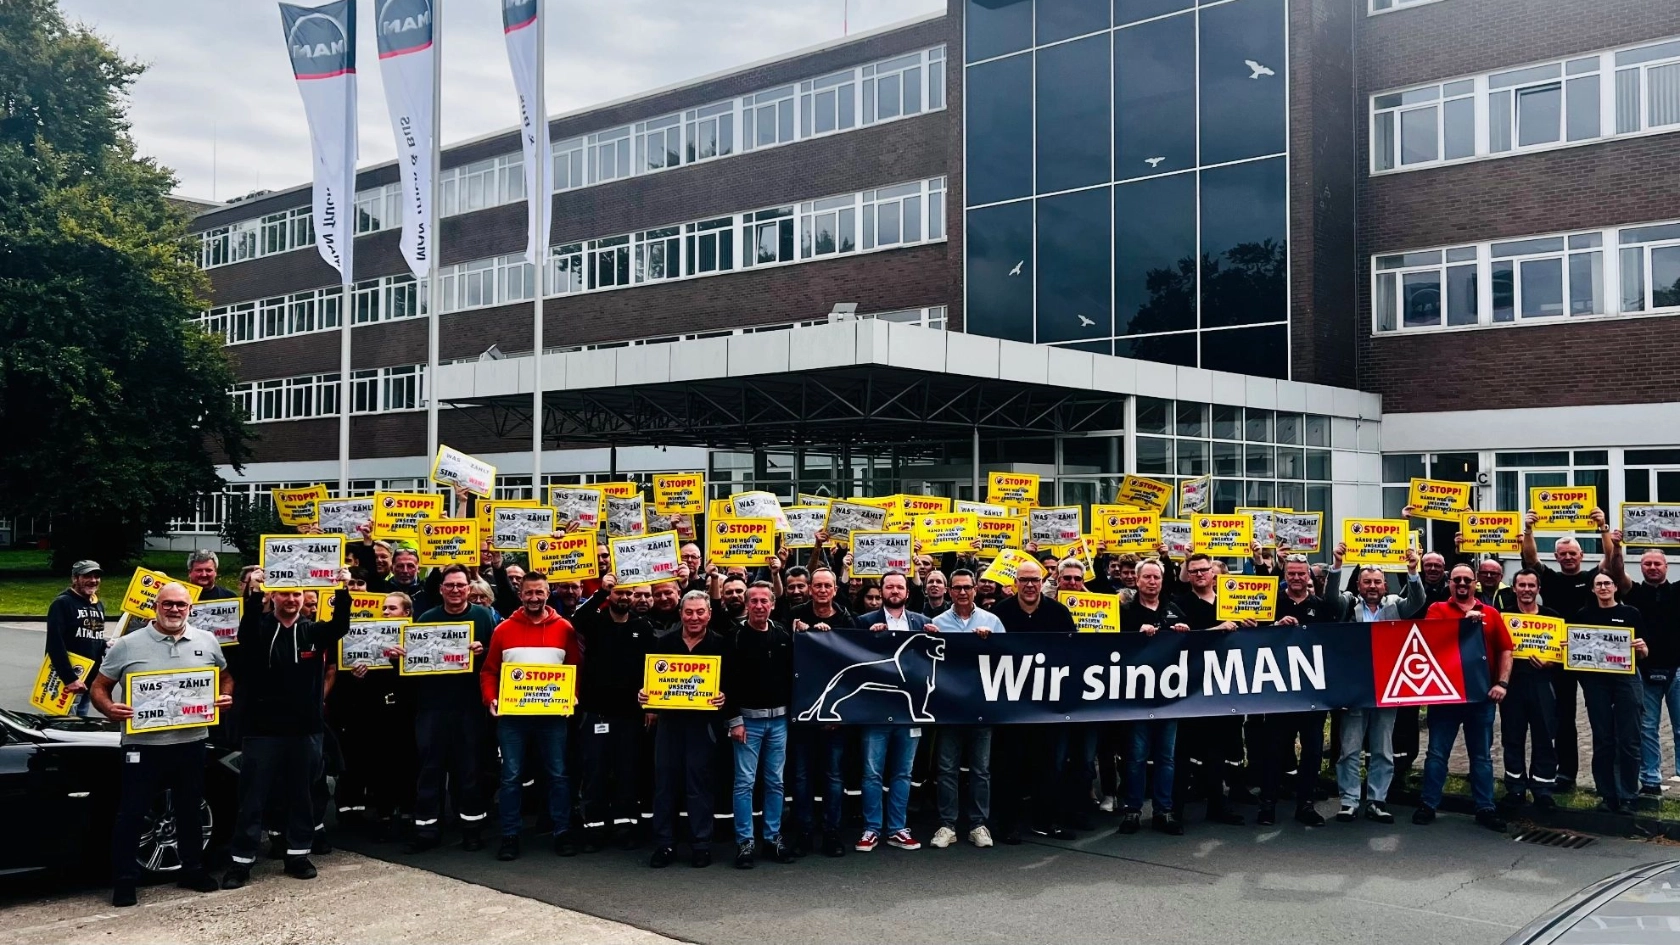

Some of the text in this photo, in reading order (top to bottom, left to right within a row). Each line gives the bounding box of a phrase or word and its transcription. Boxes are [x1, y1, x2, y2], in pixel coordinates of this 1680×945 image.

[446, 453, 460, 462] WAS
[440, 468, 457, 478] SIND
[1478, 474, 1488, 483] C
[1139, 482, 1165, 493] STOPP!
[1429, 486, 1461, 495] STOPP!
[288, 492, 318, 501] STOPP!
[397, 500, 434, 509] STOPP!
[913, 502, 942, 510] STOPP!
[1120, 517, 1151, 525] STOPP!
[434, 526, 469, 534] STOPP!
[983, 522, 1014, 531] STOPP!
[1364, 526, 1399, 534] STOPP!
[550, 540, 587, 550] STOPP!
[648, 540, 672, 550] ZÄHLT
[652, 563, 672, 572] WIR!
[1238, 582, 1270, 590] STOPP!
[1079, 599, 1110, 608] STOPP!
[211, 607, 236, 615] ZÄHLT
[1522, 621, 1556, 631] STOPP!
[441, 631, 467, 639] ZÄHLT
[1603, 634, 1627, 642] ZÄHLT
[670, 663, 710, 672] STOPP!
[525, 672, 565, 681] STOPP!
[978, 645, 1327, 702] Wir sind MAN
[139, 678, 211, 691] WAS ZÄHLT
[138, 705, 207, 719] SIND WIR!
